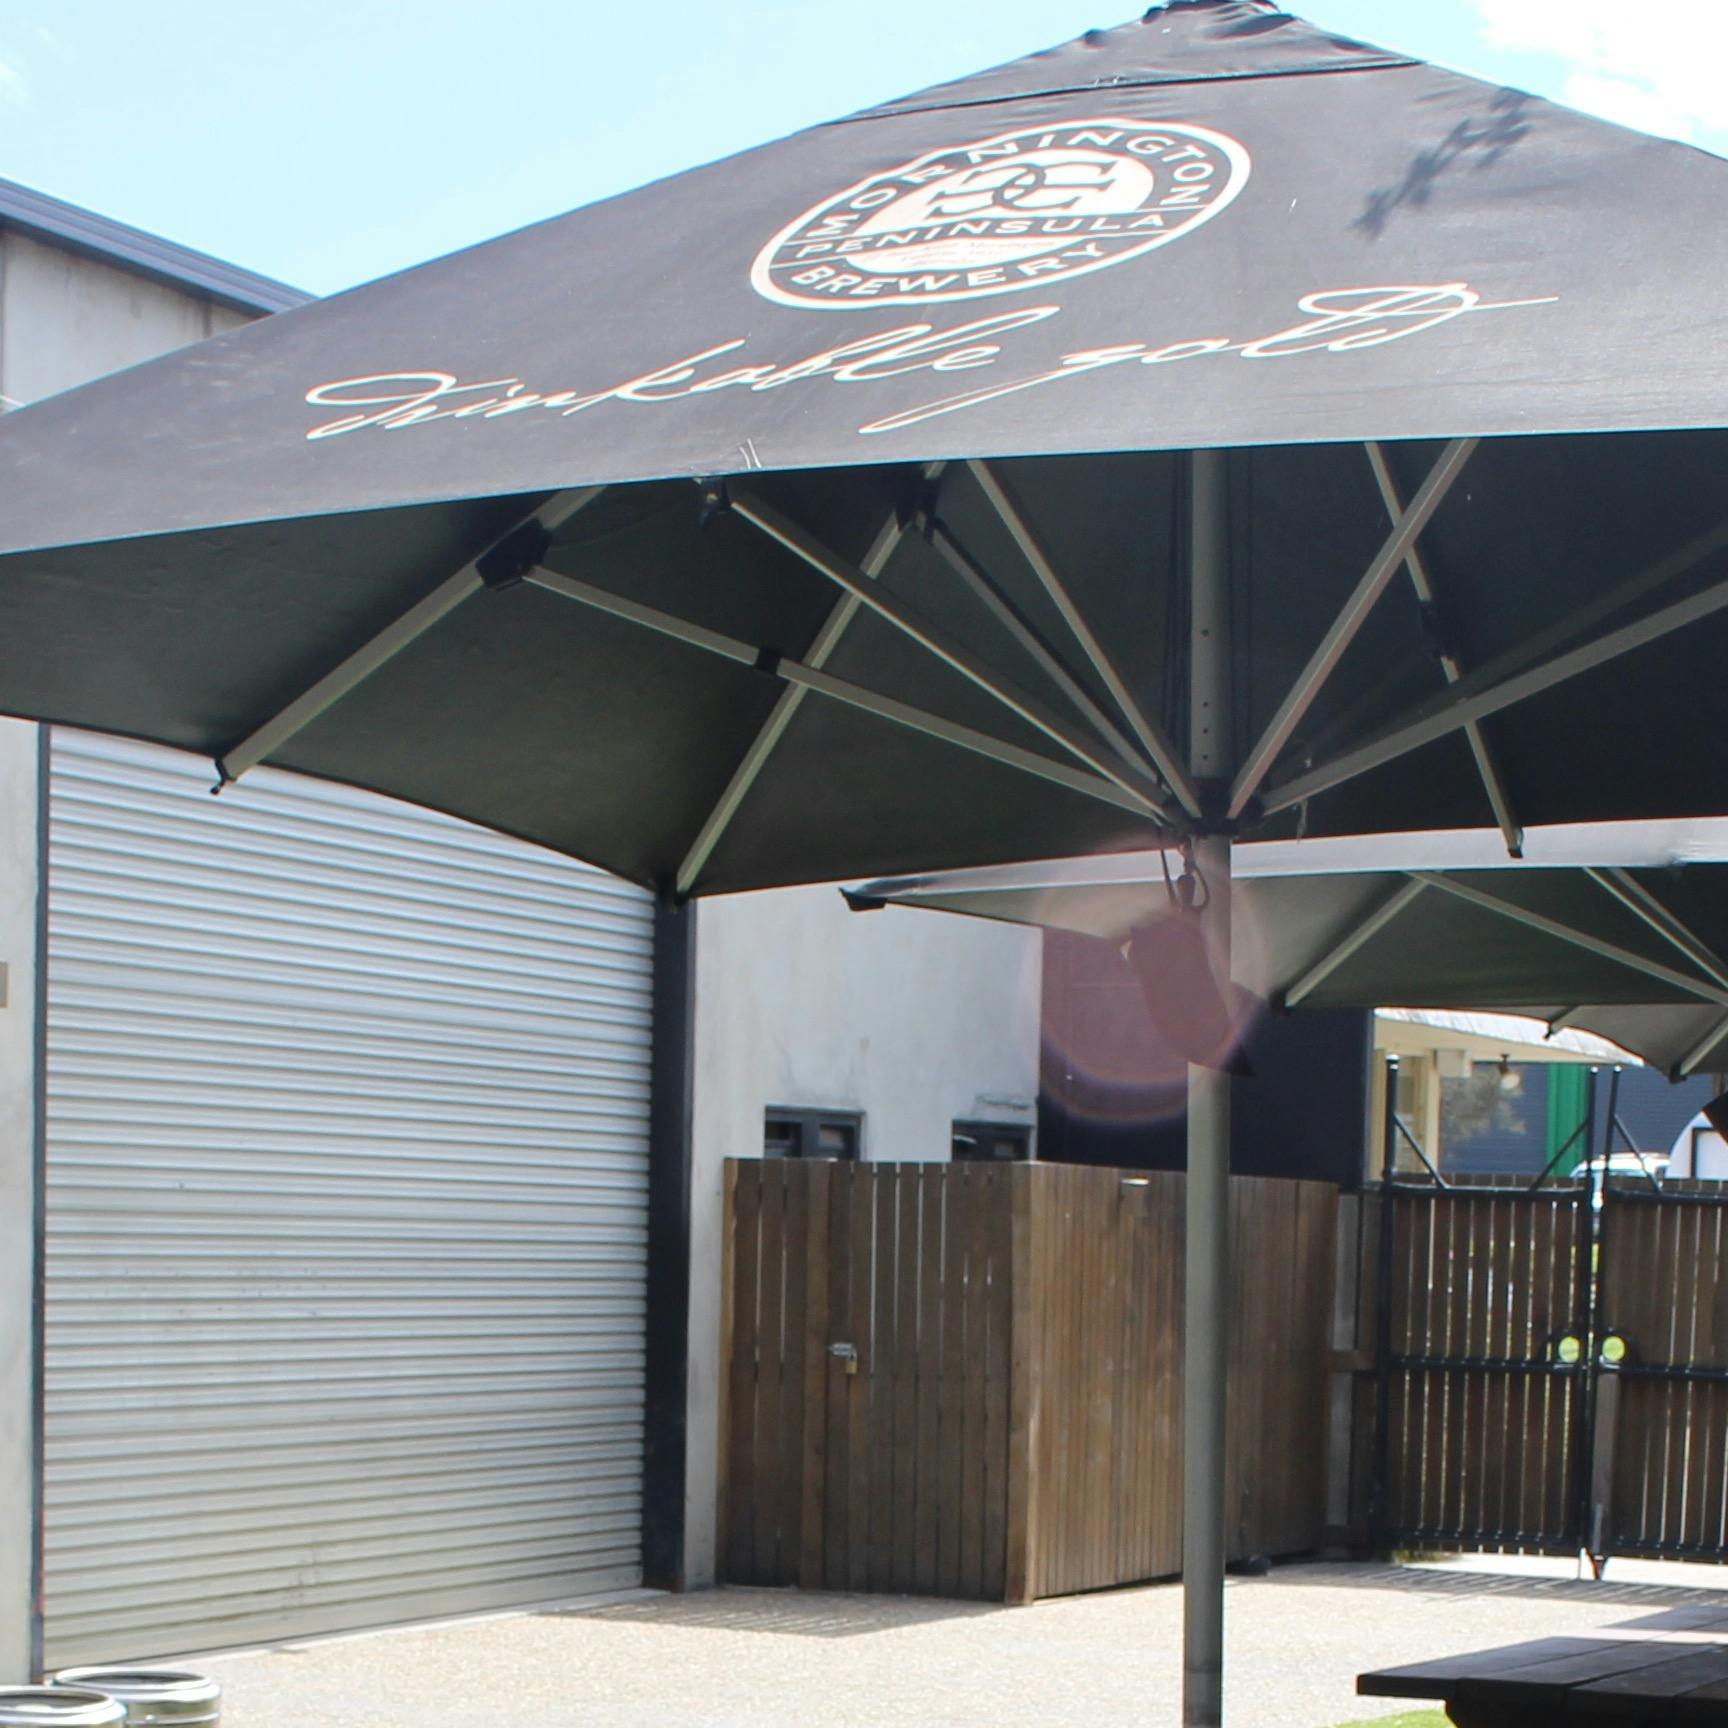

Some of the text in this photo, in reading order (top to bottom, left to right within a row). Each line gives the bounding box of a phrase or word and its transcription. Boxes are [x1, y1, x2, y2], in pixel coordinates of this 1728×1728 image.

[805, 129, 1215, 238] MORNINGTON
[798, 213, 1166, 258] PENINSULA
[792, 242, 1105, 296] BREWERY
